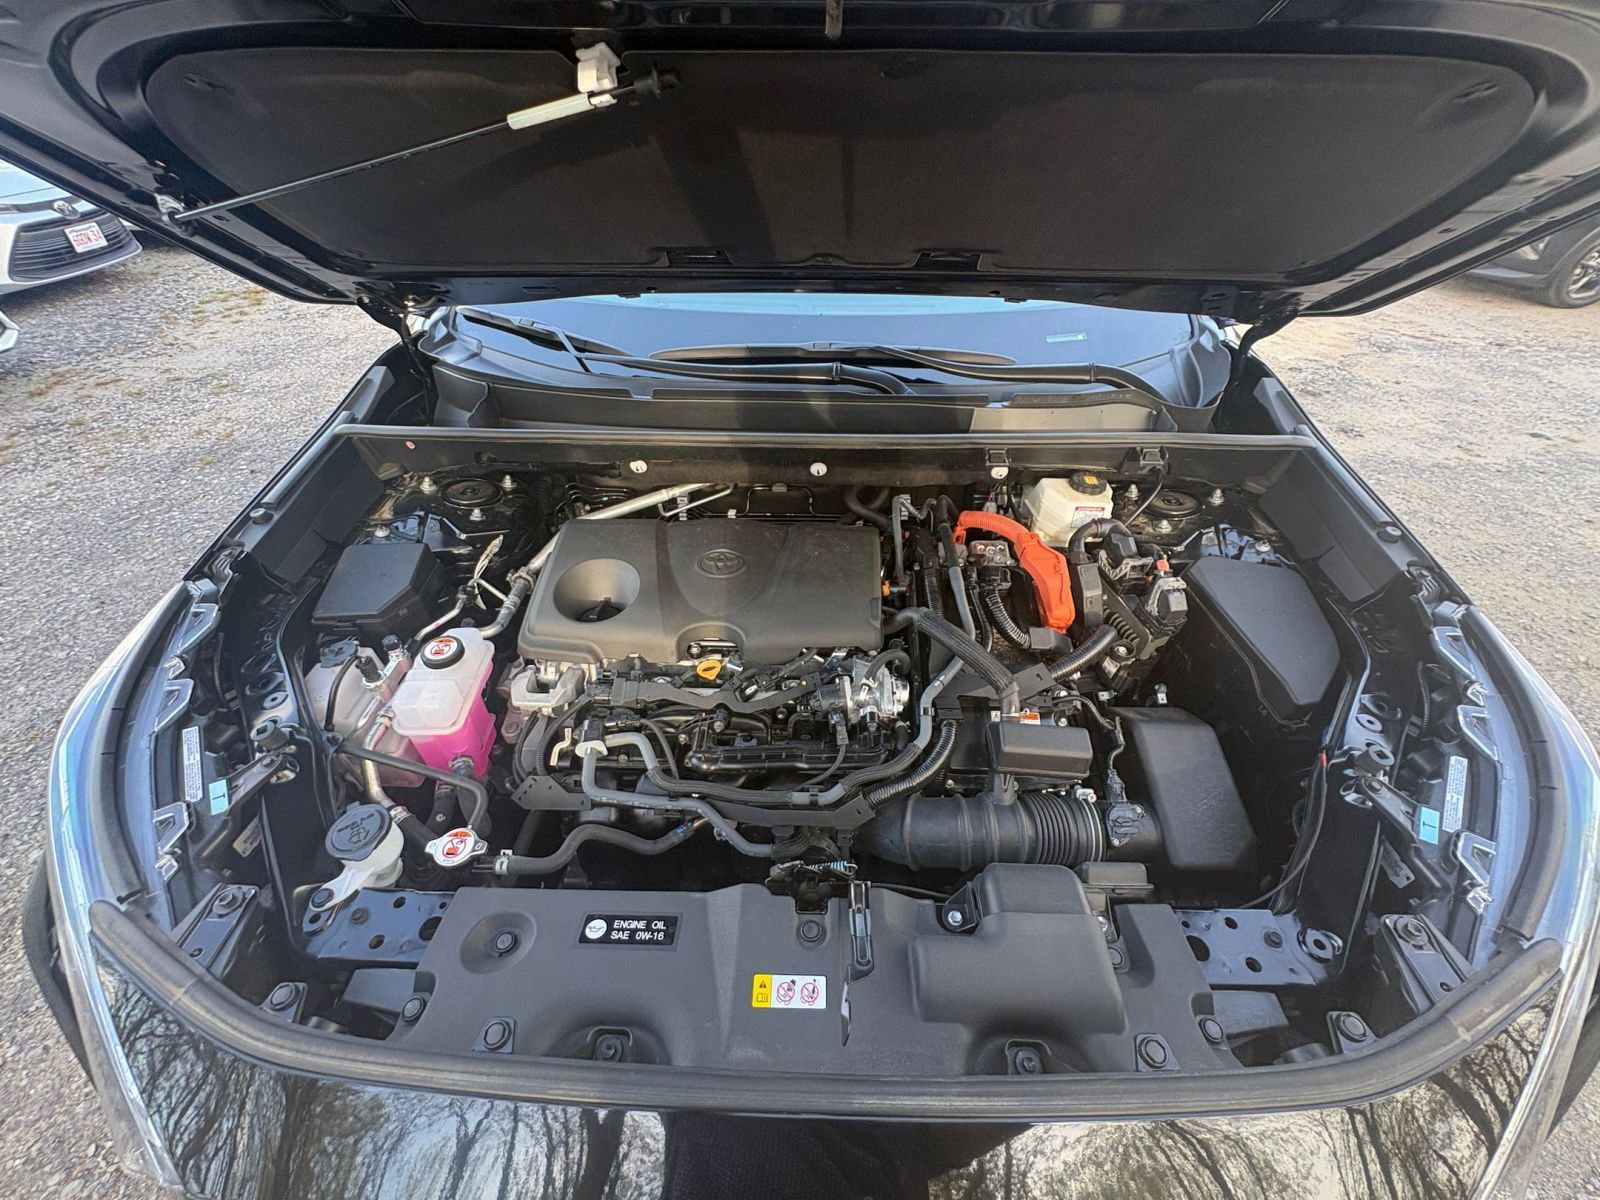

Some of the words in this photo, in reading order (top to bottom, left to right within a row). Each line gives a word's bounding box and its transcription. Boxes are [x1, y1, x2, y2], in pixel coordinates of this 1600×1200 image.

[613, 919, 647, 930] ENGINE
[651, 920, 667, 930] OIL
[610, 930, 631, 941] SAE
[635, 931, 665, 941] 0W-16
